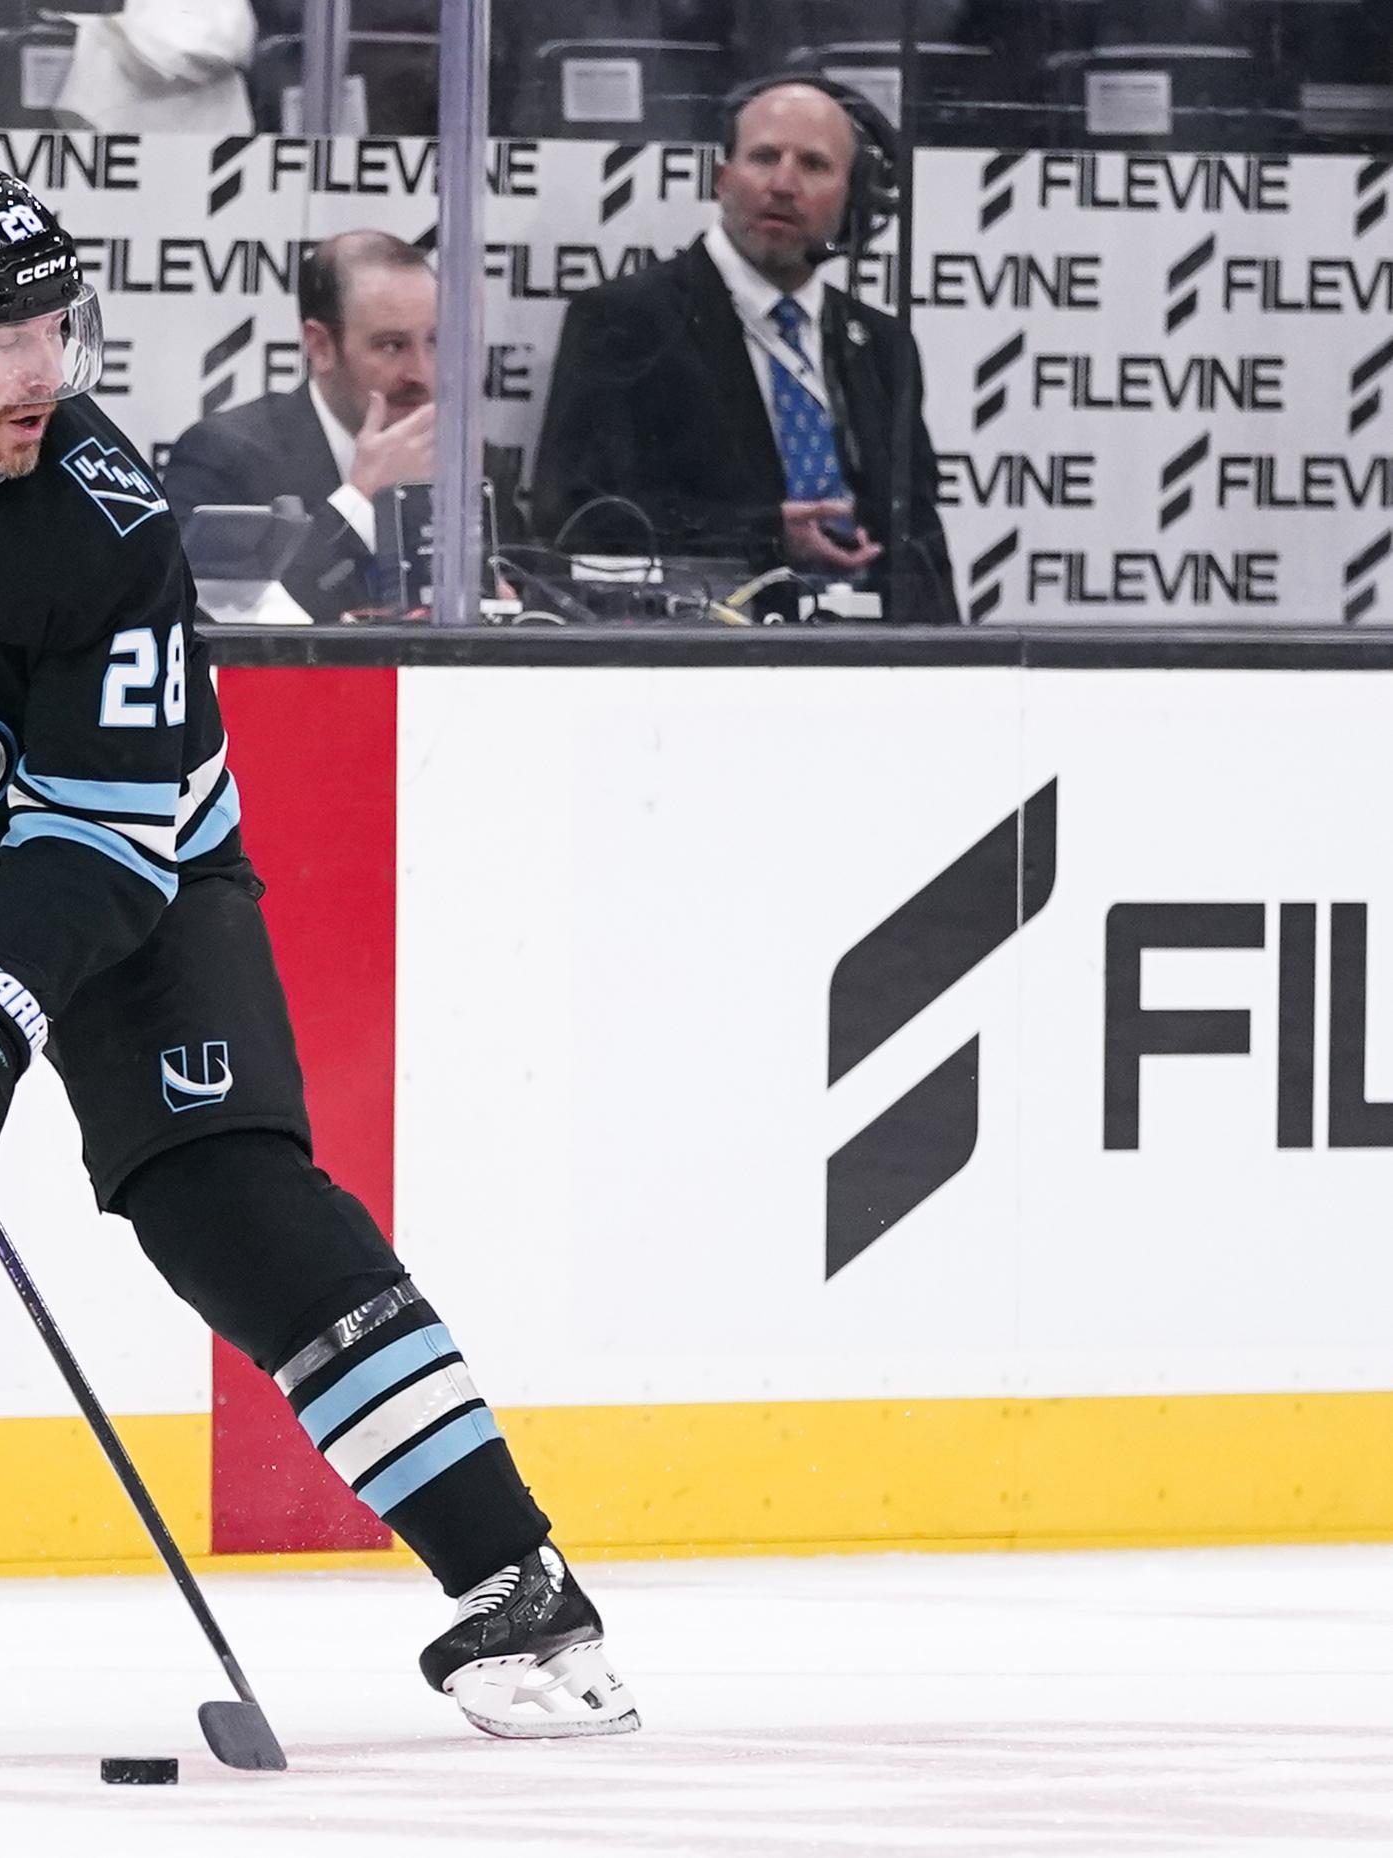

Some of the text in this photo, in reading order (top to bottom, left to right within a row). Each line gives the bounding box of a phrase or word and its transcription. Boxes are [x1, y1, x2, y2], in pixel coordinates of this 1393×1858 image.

[1038, 156, 1290, 212] FILEVINE
[16, 254, 67, 285] CCM
[1033, 355, 1284, 410] FILEVINE
[73, 454, 151, 495] UTAH
[935, 454, 1095, 507] EVINE
[1028, 552, 1279, 605] FILEVINE
[99, 622, 186, 728] 28
